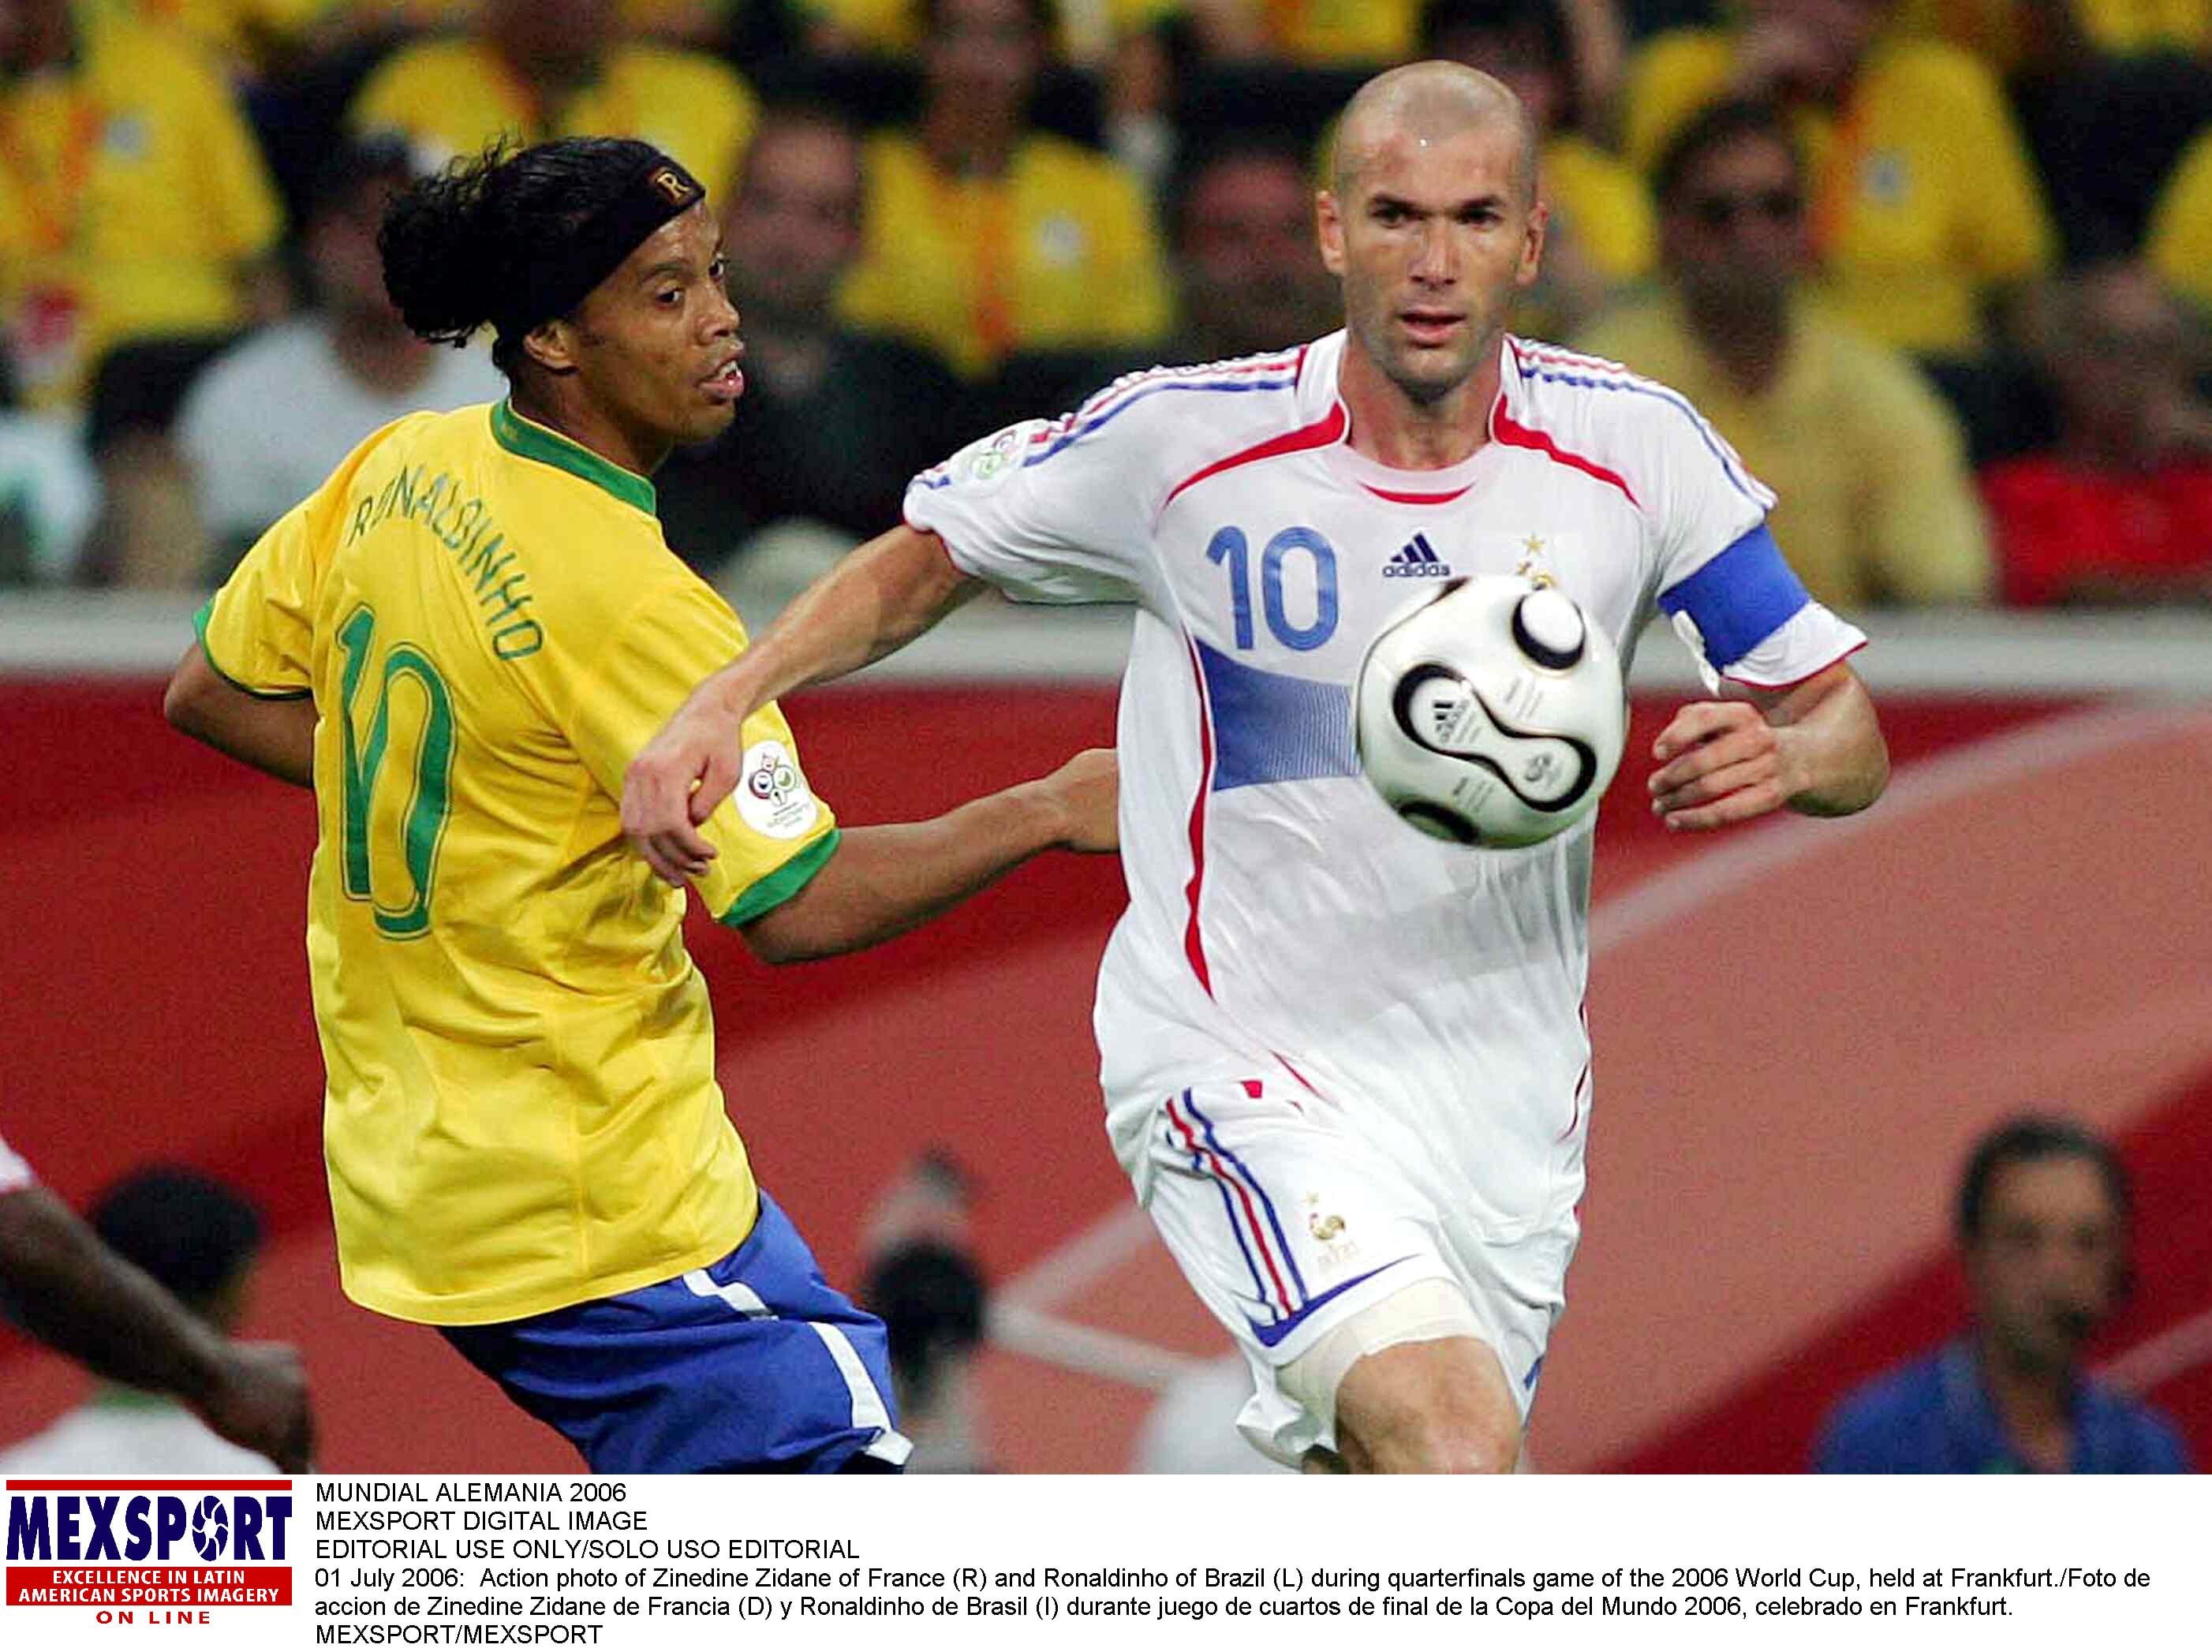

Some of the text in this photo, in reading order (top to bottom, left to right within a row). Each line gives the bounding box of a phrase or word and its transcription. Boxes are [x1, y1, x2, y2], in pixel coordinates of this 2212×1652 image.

[347, 463, 544, 661] RONALDINHO
[1205, 525, 1340, 652] 10
[1382, 561, 1451, 577] adidas
[335, 602, 458, 940] 10
